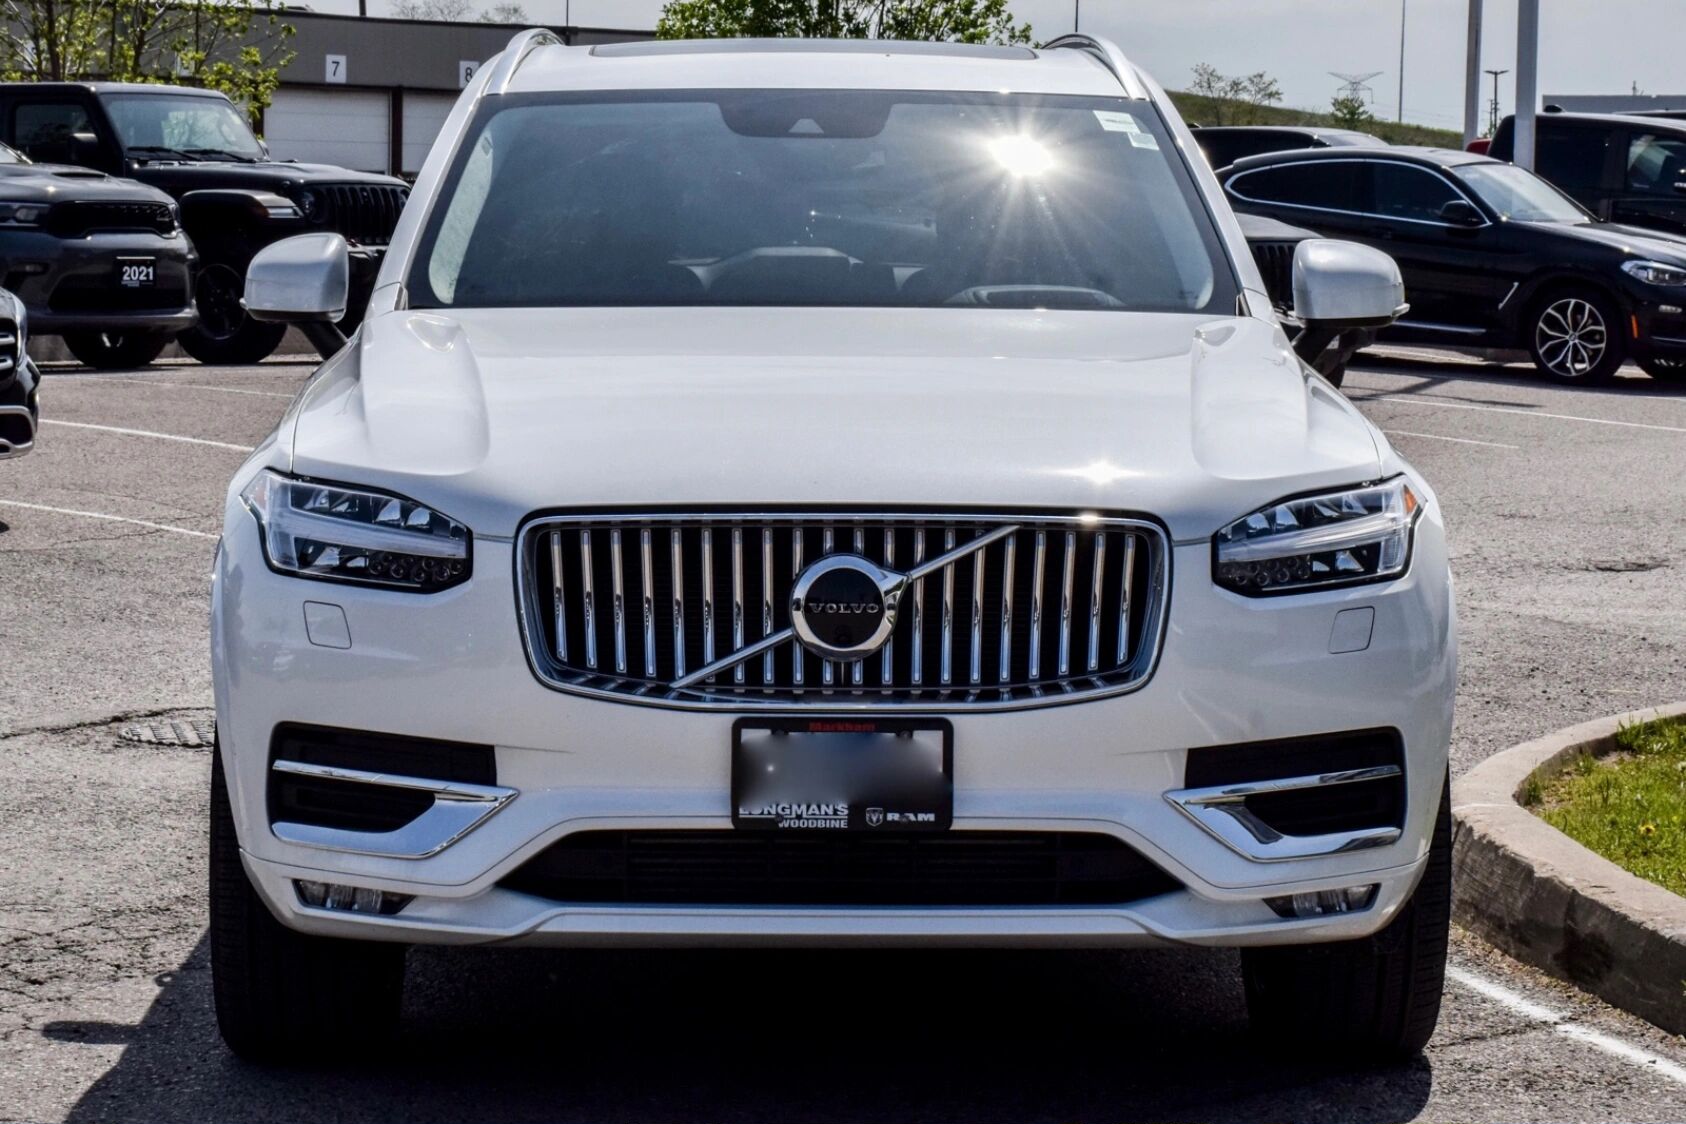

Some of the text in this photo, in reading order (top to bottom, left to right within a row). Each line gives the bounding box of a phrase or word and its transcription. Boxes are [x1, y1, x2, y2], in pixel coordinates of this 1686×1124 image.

[331, 61, 340, 77] 7
[464, 66, 473, 83] 8
[122, 265, 154, 281] 2021
[808, 602, 880, 614] VOLVO
[808, 721, 876, 732] Markham
[886, 812, 936, 822] RAM
[778, 818, 849, 829] WOODBINE
